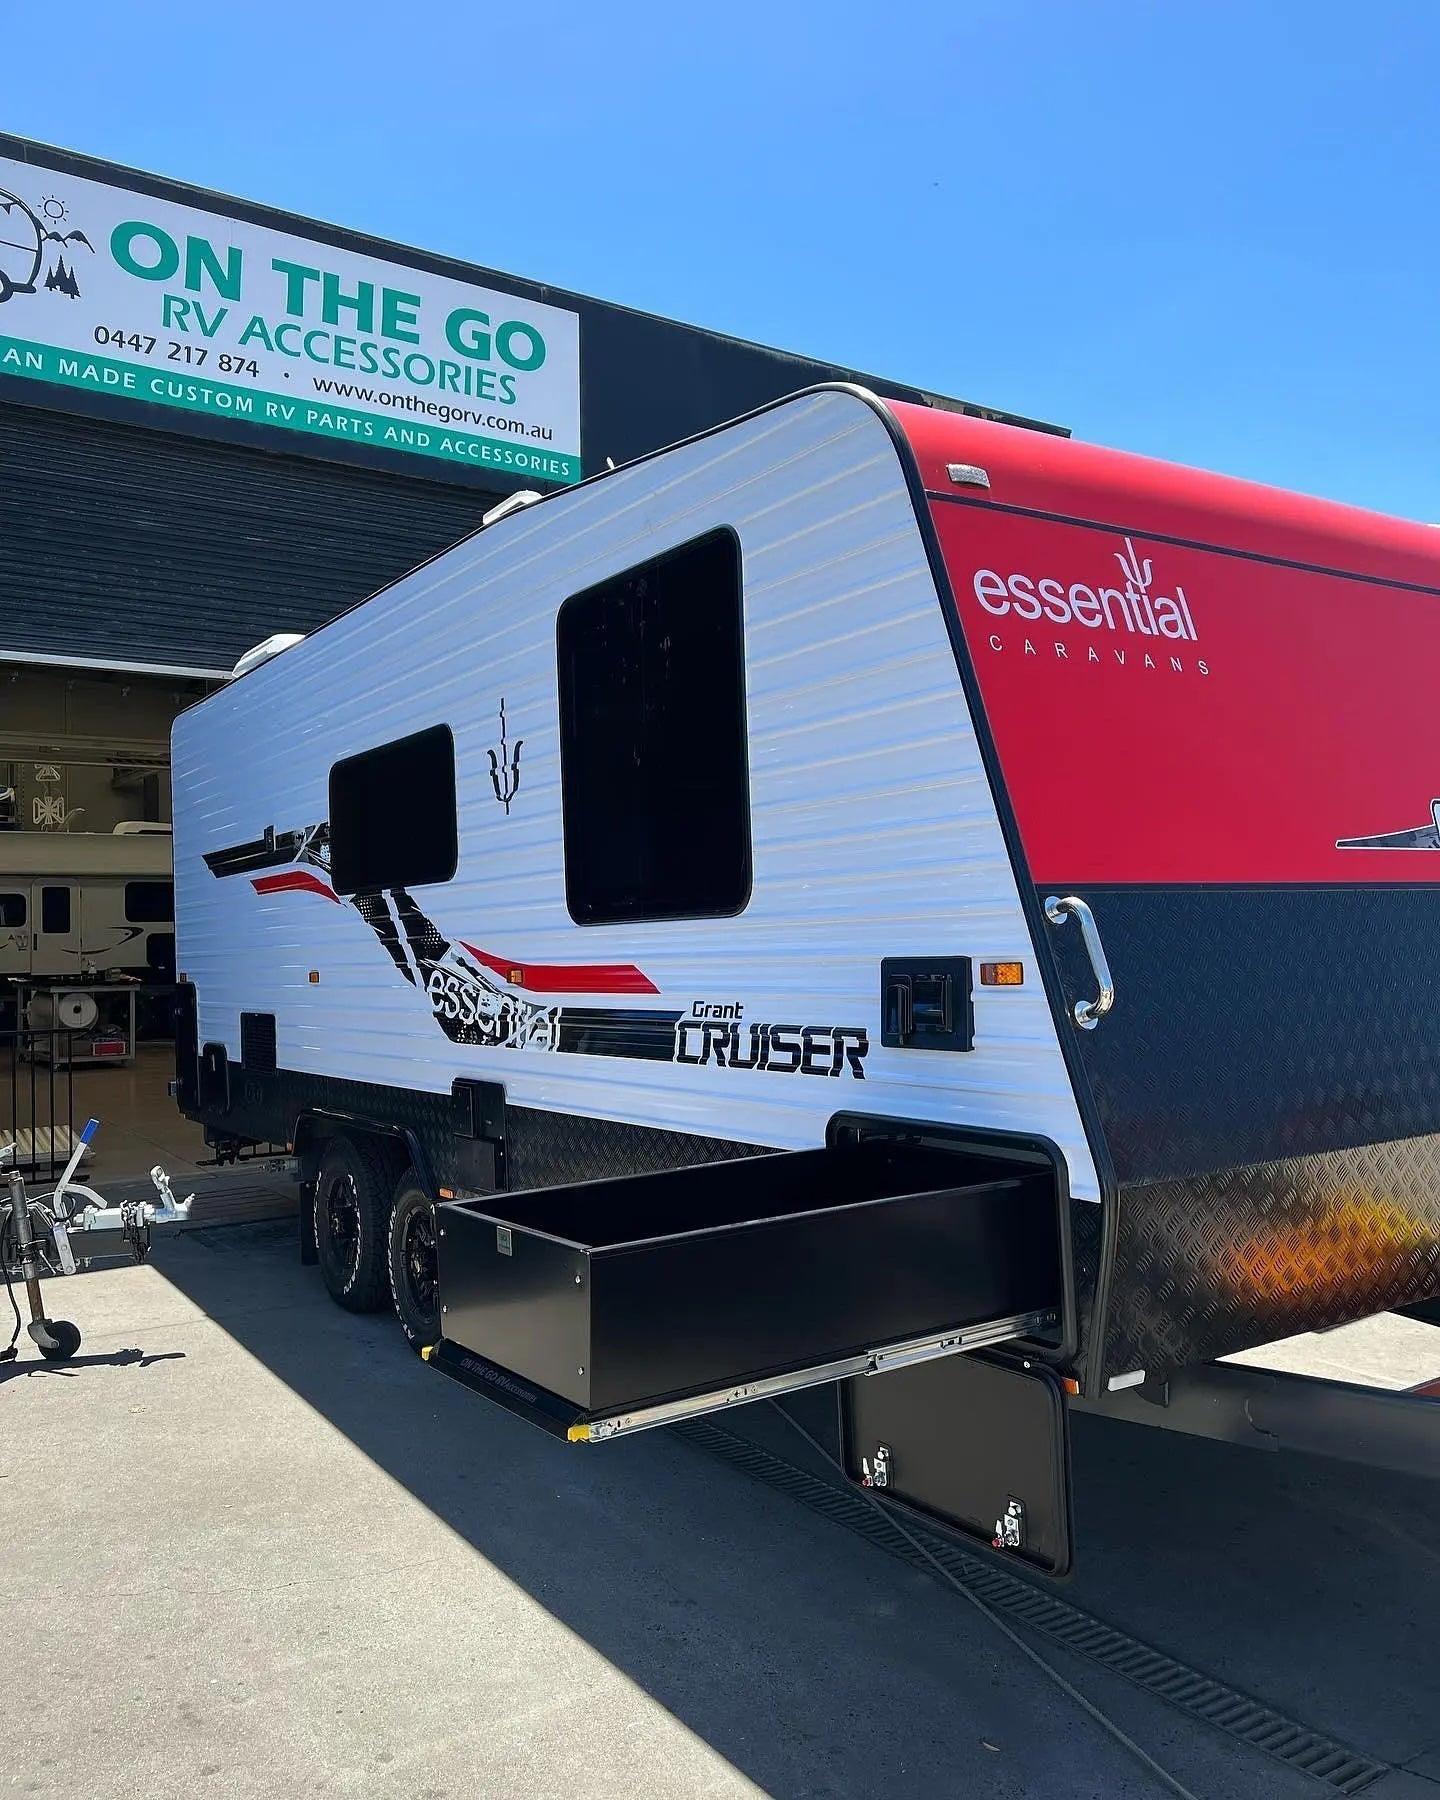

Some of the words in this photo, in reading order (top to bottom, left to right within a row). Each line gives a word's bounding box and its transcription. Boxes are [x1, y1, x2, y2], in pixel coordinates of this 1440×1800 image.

[110, 220, 243, 302] ON
[272, 258, 421, 345] THE
[445, 307, 546, 372] GO
[94, 325, 157, 355] 0447
[167, 341, 208, 366] 217
[218, 353, 260, 378] 874
[312, 377, 554, 441] www.onthegorv.com.au
[162, 293, 229, 338] RV
[238, 315, 517, 405] ACCESSORIES
[58, 358, 136, 389] MADE
[150, 378, 253, 413] CUSTOM
[266, 402, 296, 420] RV
[307, 409, 374, 436] PARTS
[384, 426, 431, 447] AND
[439, 437, 570, 477] ACCESSORIES
[973, 567, 1199, 641] essential
[989, 635, 1210, 676] CARAVANS
[427, 969, 563, 1053] essential
[692, 1000, 744, 1020] Grant
[676, 1020, 870, 1080] CRUISER
[460, 1357, 475, 1369] ON
[471, 1362, 489, 1376] THE
[484, 1369, 499, 1381] GO
